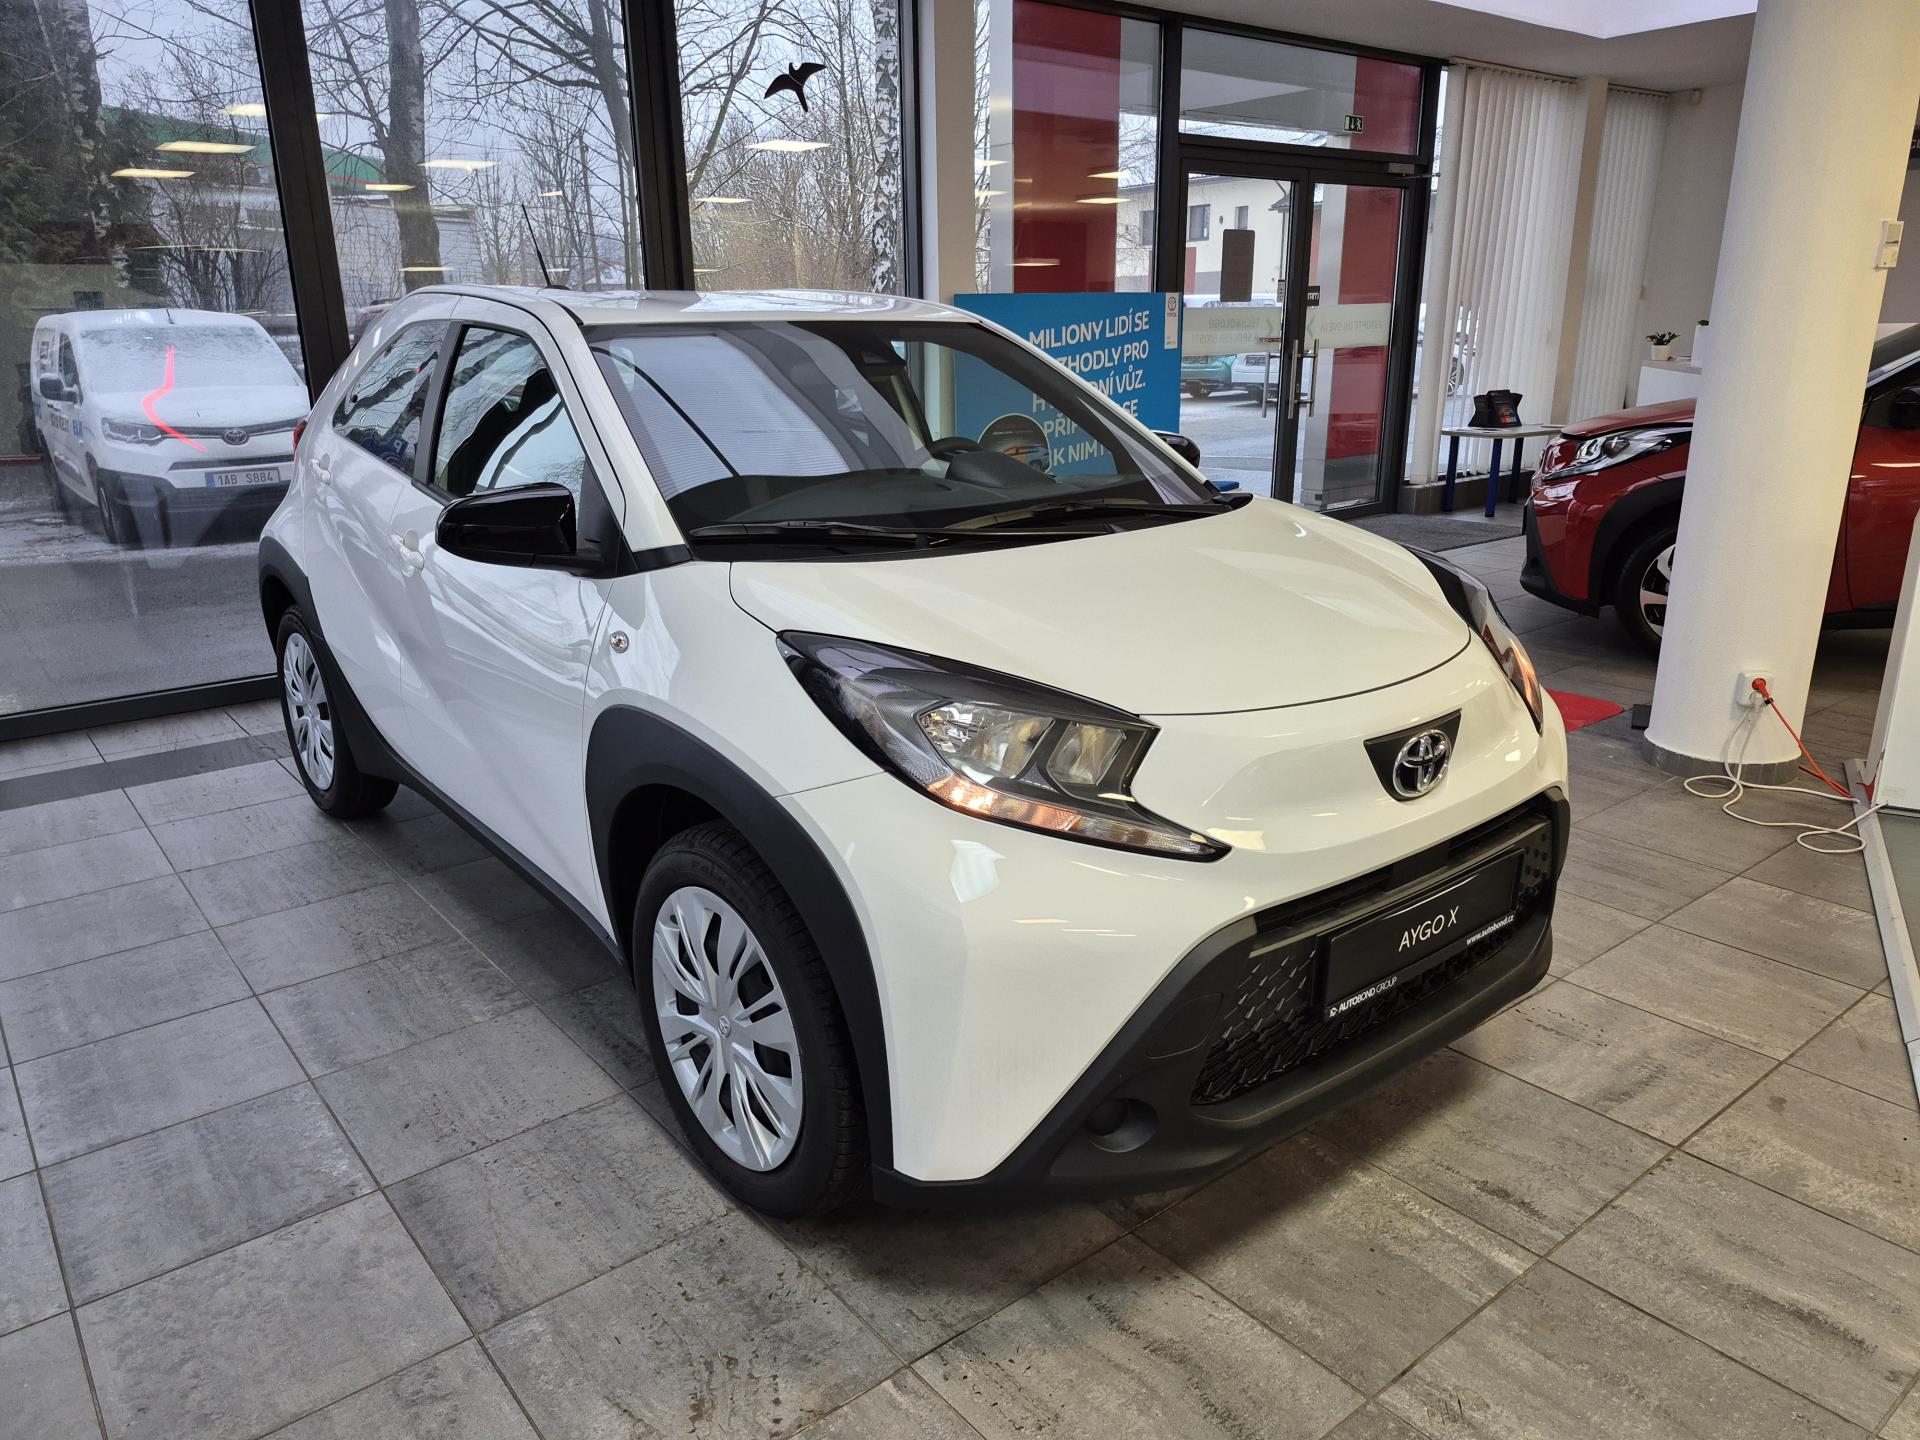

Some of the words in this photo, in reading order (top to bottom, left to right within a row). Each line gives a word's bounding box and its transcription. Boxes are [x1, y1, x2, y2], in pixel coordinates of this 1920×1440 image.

[1028, 319, 1104, 350] MILIONY
[1105, 307, 1134, 338] LIDÍ
[1134, 310, 1150, 332] SE
[1057, 346, 1121, 374] ZHODLY
[1123, 339, 1149, 363] PRO
[1115, 364, 1145, 394] VŮZ.
[1053, 447, 1066, 466] K
[1067, 439, 1097, 463] NIM
[218, 474, 238, 486] 1AB
[246, 471, 274, 484] S884
[1398, 914, 1445, 953] AYGO
[1447, 905, 1459, 928] X
[1466, 914, 1514, 945] www.autobond.cz
[1338, 987, 1376, 1013] AUTOBOND
[1375, 976, 1398, 993] GROUP
